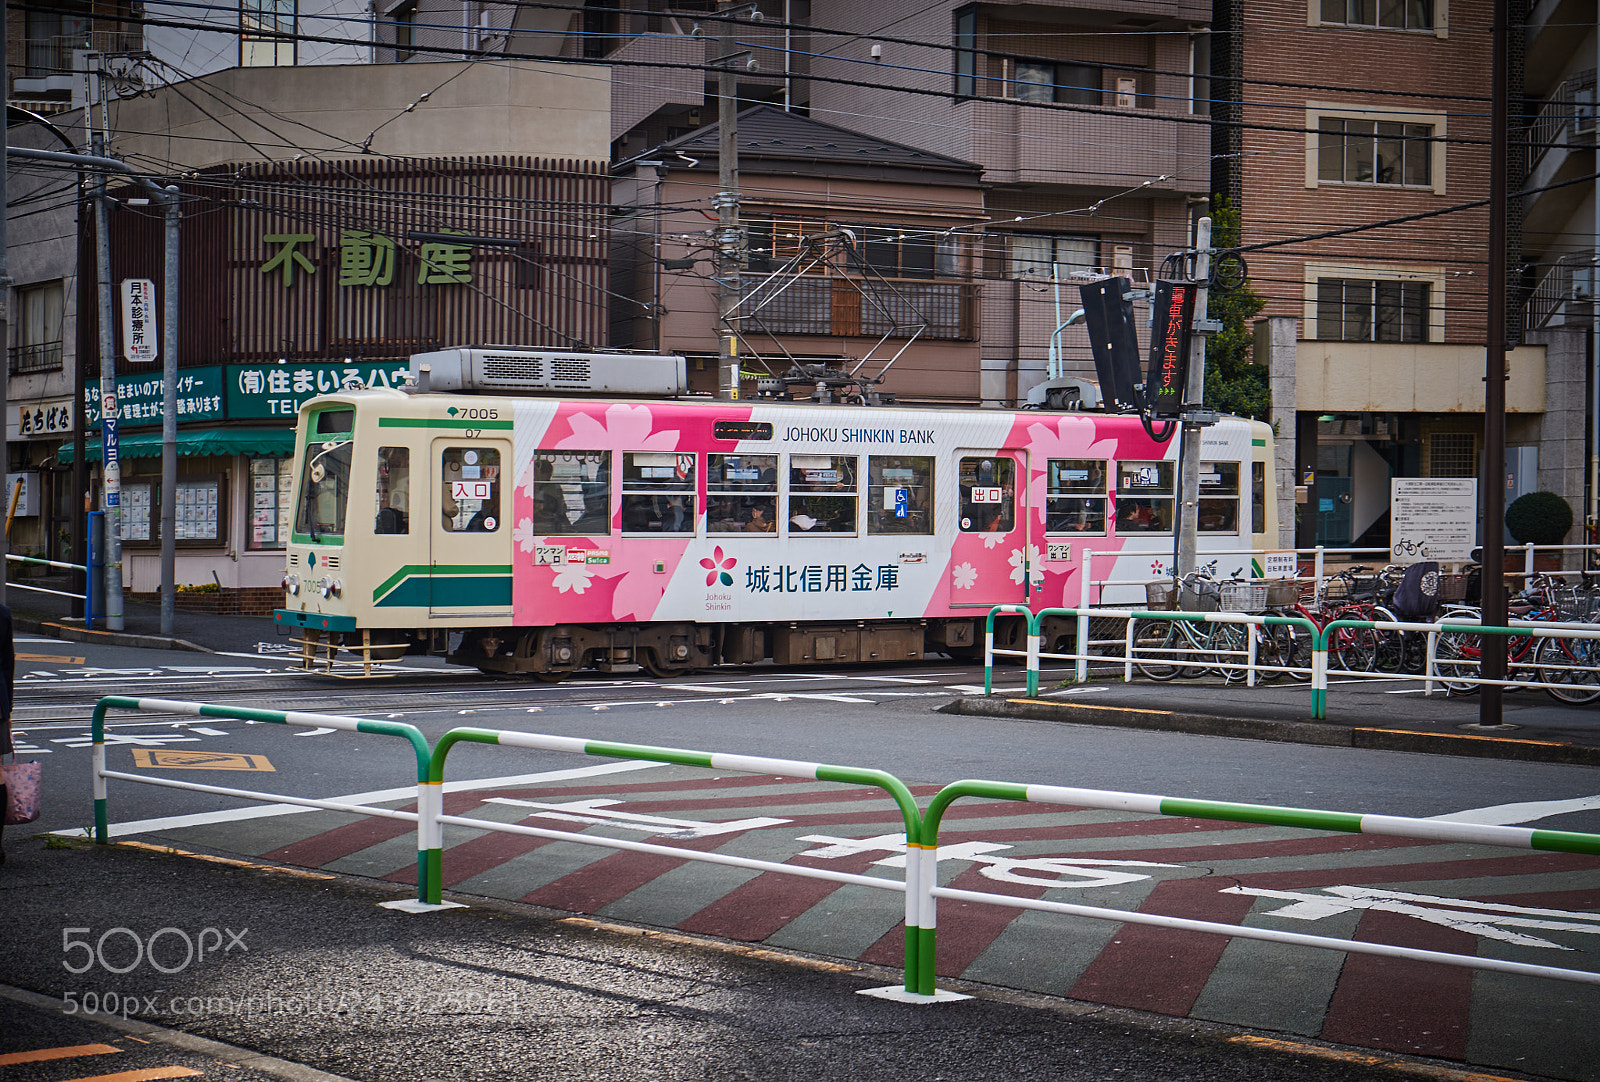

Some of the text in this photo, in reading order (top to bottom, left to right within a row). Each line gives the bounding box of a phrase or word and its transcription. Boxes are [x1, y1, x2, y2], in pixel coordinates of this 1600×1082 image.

[261, 229, 473, 287] 不動産
[130, 282, 145, 345] 月本診療所
[1161, 286, 1187, 387] 電車がきます
[84, 375, 204, 403] あな住まいのアイザー
[267, 399, 301, 414] TEL
[459, 408, 498, 419] 7005
[22, 406, 69, 433] たちばな
[105, 419, 118, 460] マルヨ
[465, 428, 482, 439] 07
[782, 427, 936, 444] JOHOKU SHINKIN BANK
[455, 483, 487, 497] 入口
[974, 488, 999, 502] 出口
[536, 547, 563, 555] ワンマン
[539, 555, 561, 563] 入口
[745, 562, 900, 594] 城北信用金庫
[304, 579, 321, 594] 7005
[705, 593, 732, 601] Johoku
[705, 602, 732, 611] Shinkin
